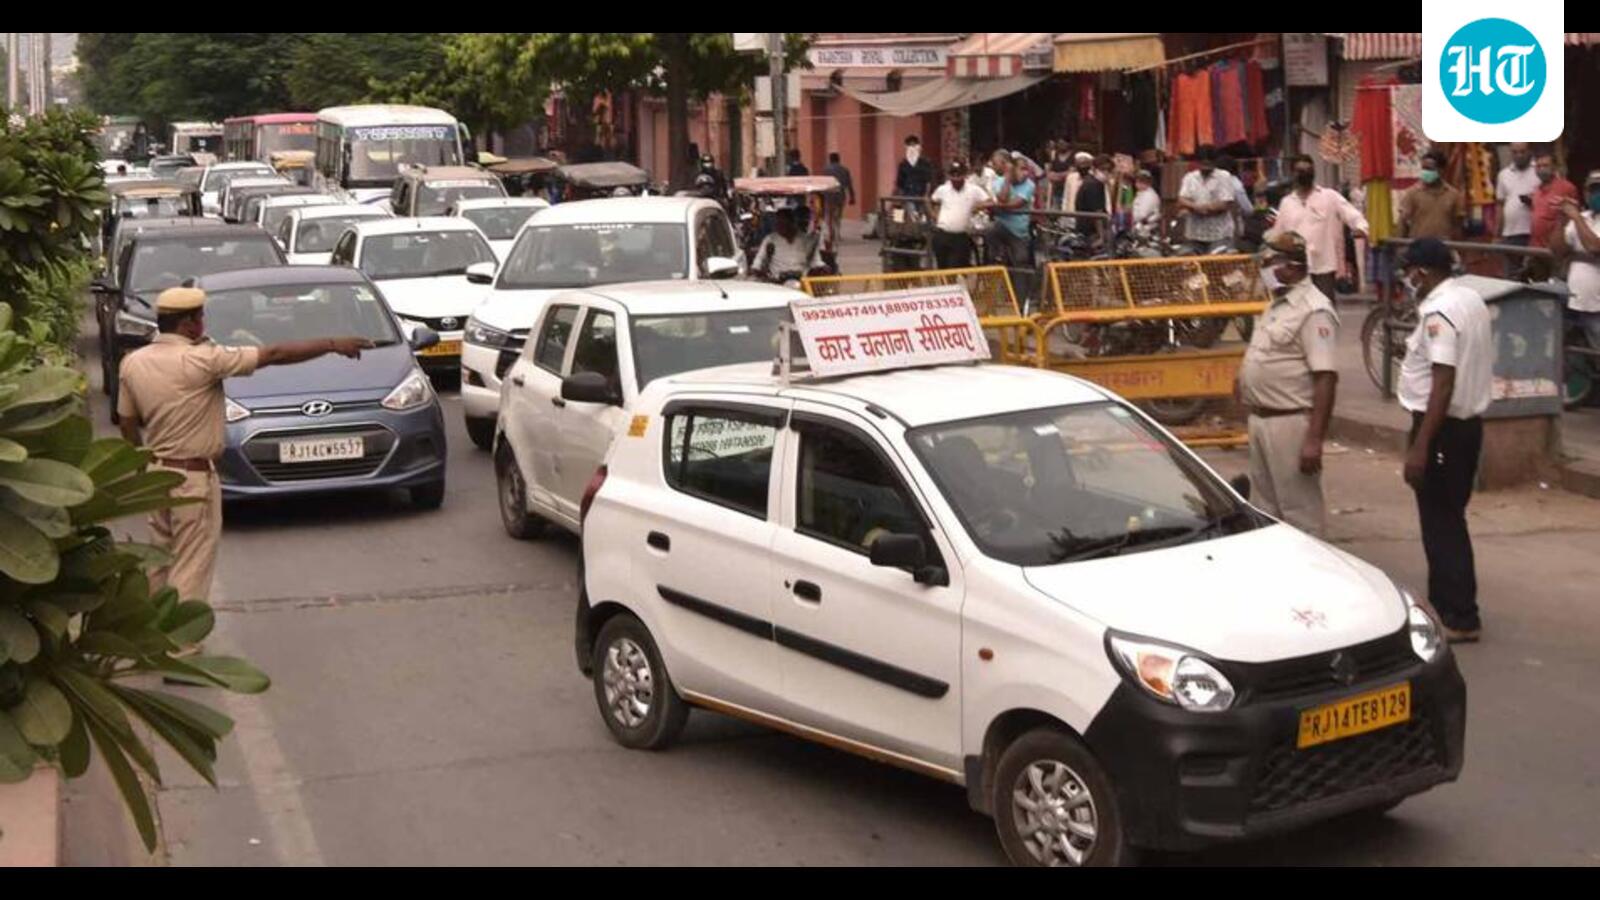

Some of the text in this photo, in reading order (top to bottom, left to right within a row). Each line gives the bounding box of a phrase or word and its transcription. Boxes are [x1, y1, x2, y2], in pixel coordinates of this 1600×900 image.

[892, 48, 940, 64] COLLECTION
[815, 336, 855, 361] कार
[857, 330, 914, 357] चलाना
[1312, 691, 1407, 737] RJ14TE8129
